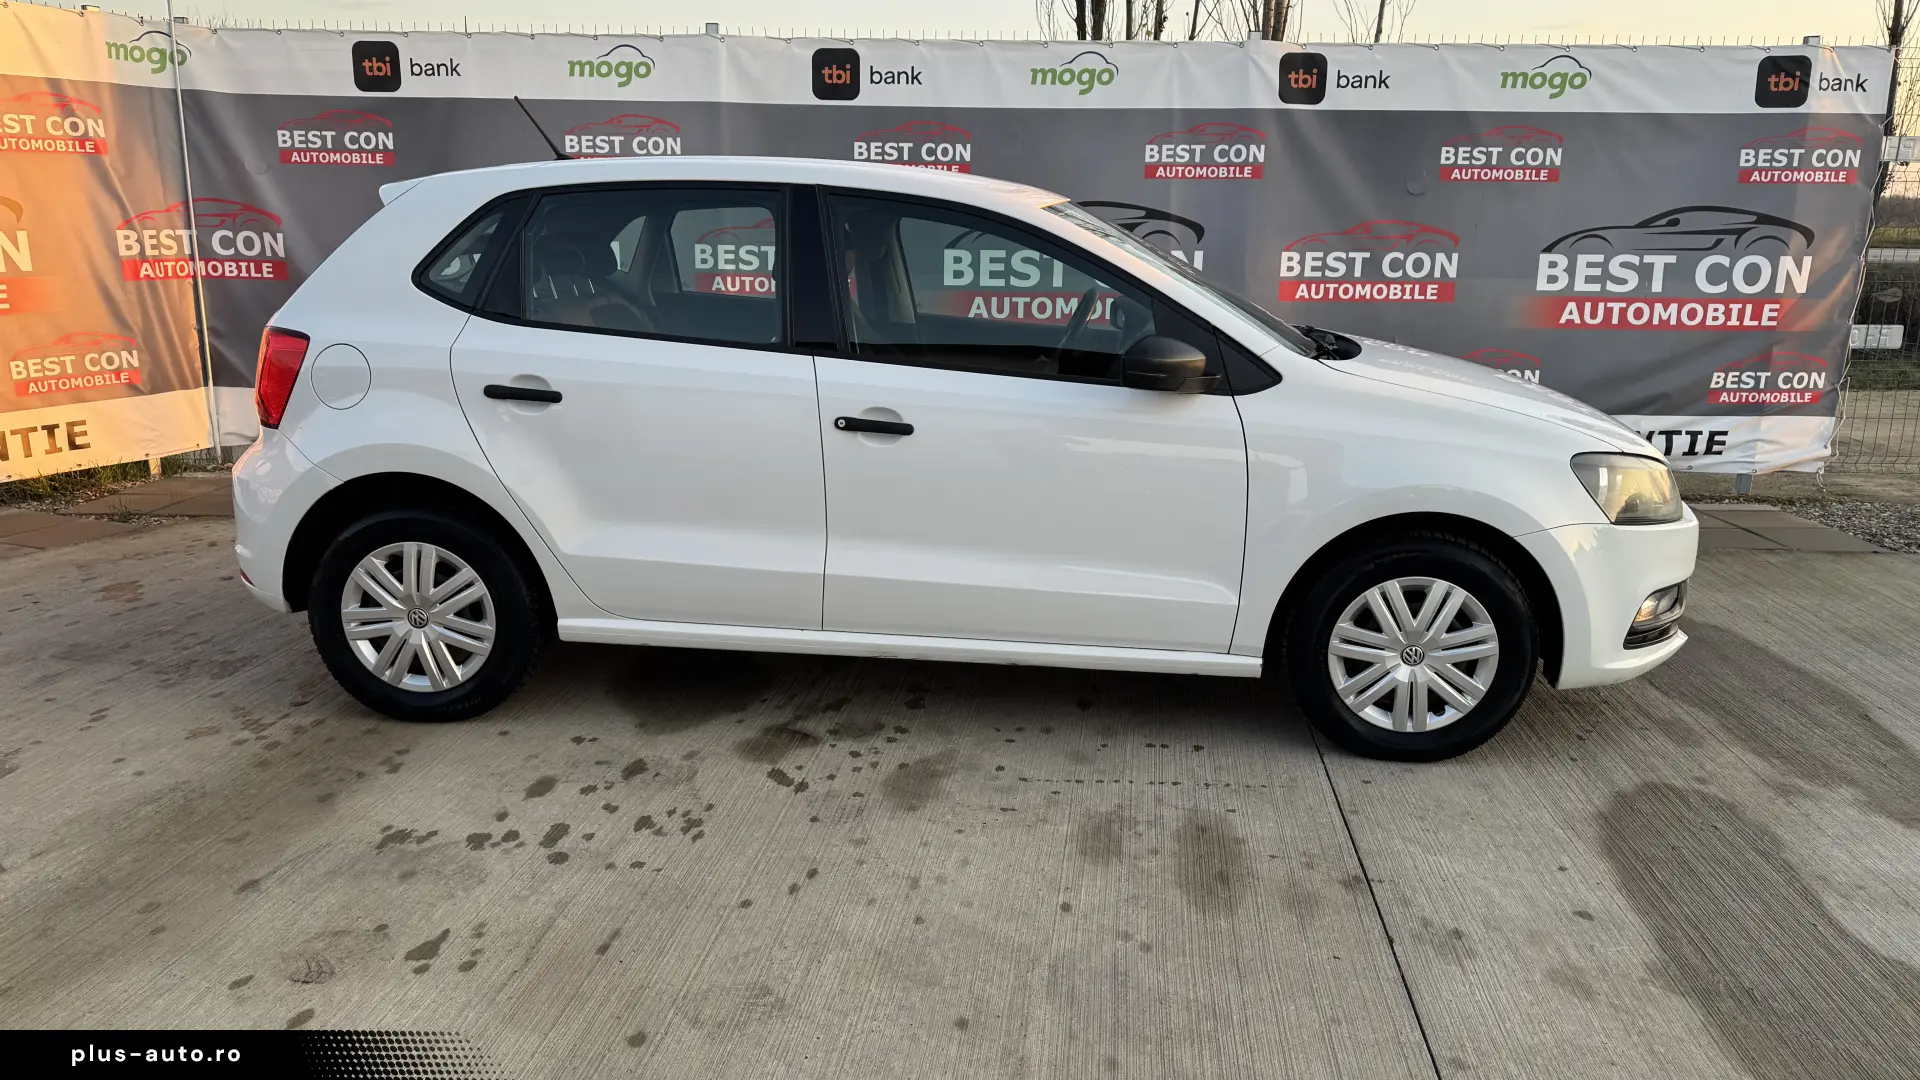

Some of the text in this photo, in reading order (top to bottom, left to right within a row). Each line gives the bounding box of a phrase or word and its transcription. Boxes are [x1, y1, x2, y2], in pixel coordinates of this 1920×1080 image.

[105, 41, 187, 74] mogo
[362, 56, 462, 77] tbi bank
[568, 60, 652, 87] mogo
[822, 64, 922, 85] tbi bank
[1030, 68, 1115, 96] mogo
[1288, 69, 1391, 89] tbi bank
[1767, 71, 1869, 93] tbi bank
[1500, 71, 1588, 100] mogo
[46, 117, 106, 138] CON
[277, 130, 394, 150] BEST CON
[564, 135, 682, 155] BEST CON
[291, 151, 384, 165] AUTOMOBILE
[853, 141, 971, 162] BEST CON
[1144, 144, 1265, 163] BEST CON
[1440, 147, 1563, 166] BEST CON
[1739, 149, 1805, 167] BEST
[1811, 149, 1862, 168] CON
[1155, 166, 1253, 178] AUTOMOBILE
[1451, 169, 1549, 181] AUTOMOBILE
[1750, 171, 1848, 183] AUTOMOBILE
[116, 229, 286, 258] BEST CON
[139, 260, 274, 278] AUTOMOBILE
[943, 249, 1064, 288] BEST
[1279, 251, 1459, 279] BEST CON
[1536, 253, 1813, 294] BEST CON
[1295, 283, 1439, 300] AUTOMOBILE
[1559, 301, 1781, 326] AUTOMOBILE
[9, 350, 140, 380] BEST CON
[28, 372, 130, 394] AUTOMOBILE
[1709, 371, 1826, 389] BEST CON
[1718, 392, 1812, 403] AUTOMOBILE
